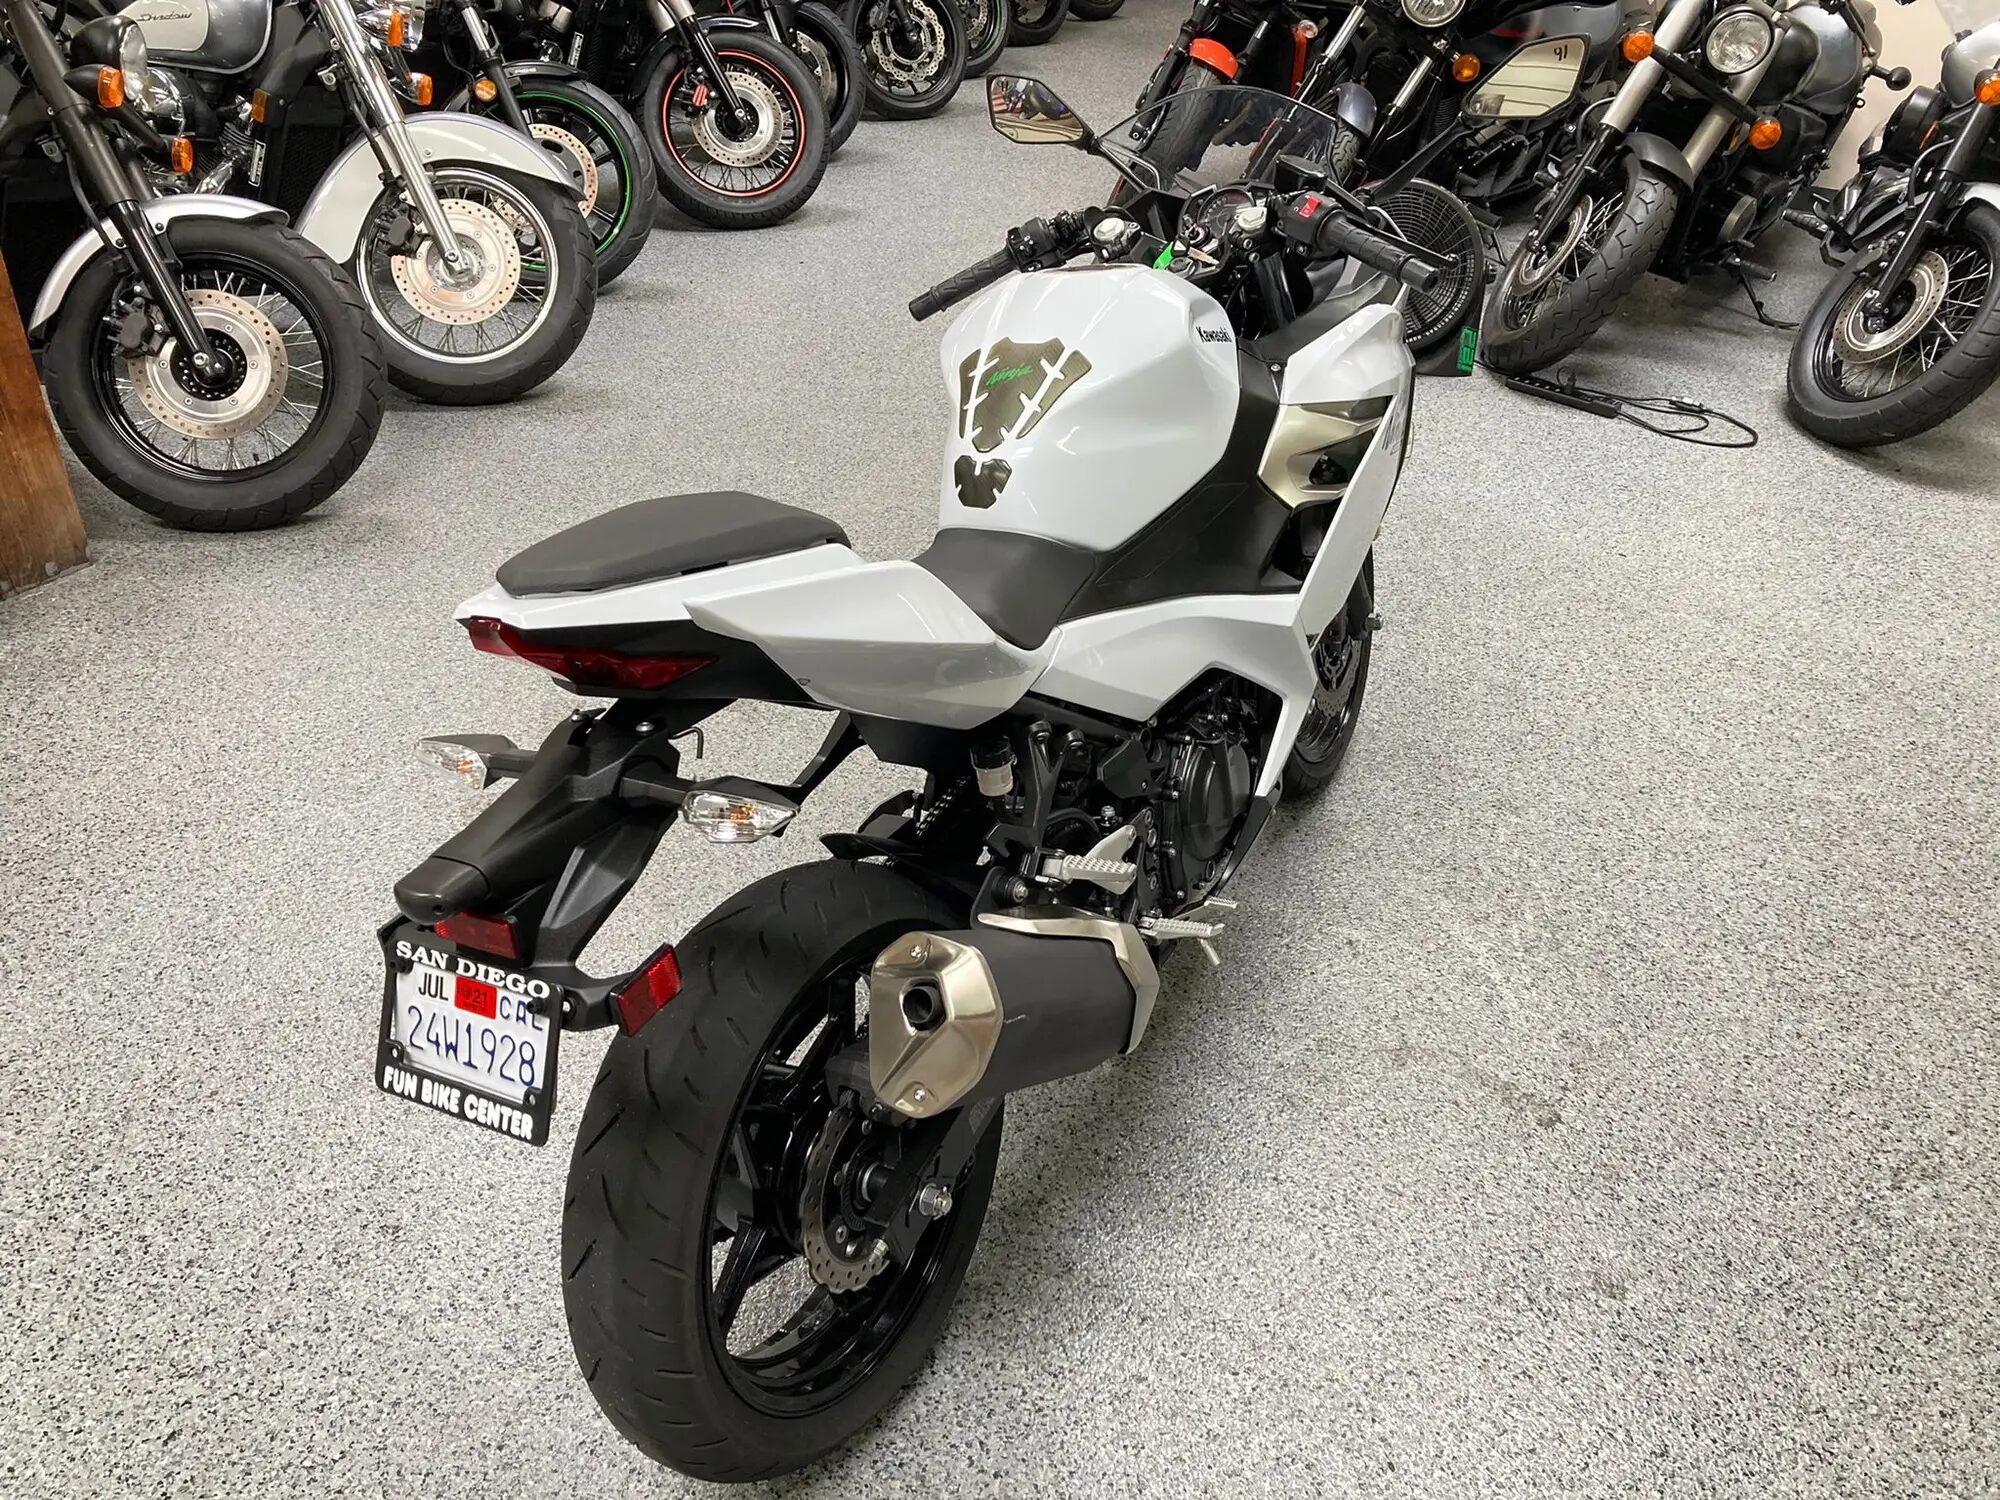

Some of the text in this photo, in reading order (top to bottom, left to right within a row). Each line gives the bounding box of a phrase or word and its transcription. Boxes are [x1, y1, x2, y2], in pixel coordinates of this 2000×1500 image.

[1195, 322, 1233, 344] Kawasaki
[985, 362, 1033, 386] Ninja
[396, 940, 550, 999] SAN DIEGO
[418, 972, 449, 1002] JUL
[408, 1005, 536, 1087] 24W1928
[383, 1065, 534, 1141] FUN BIKE CENTER
